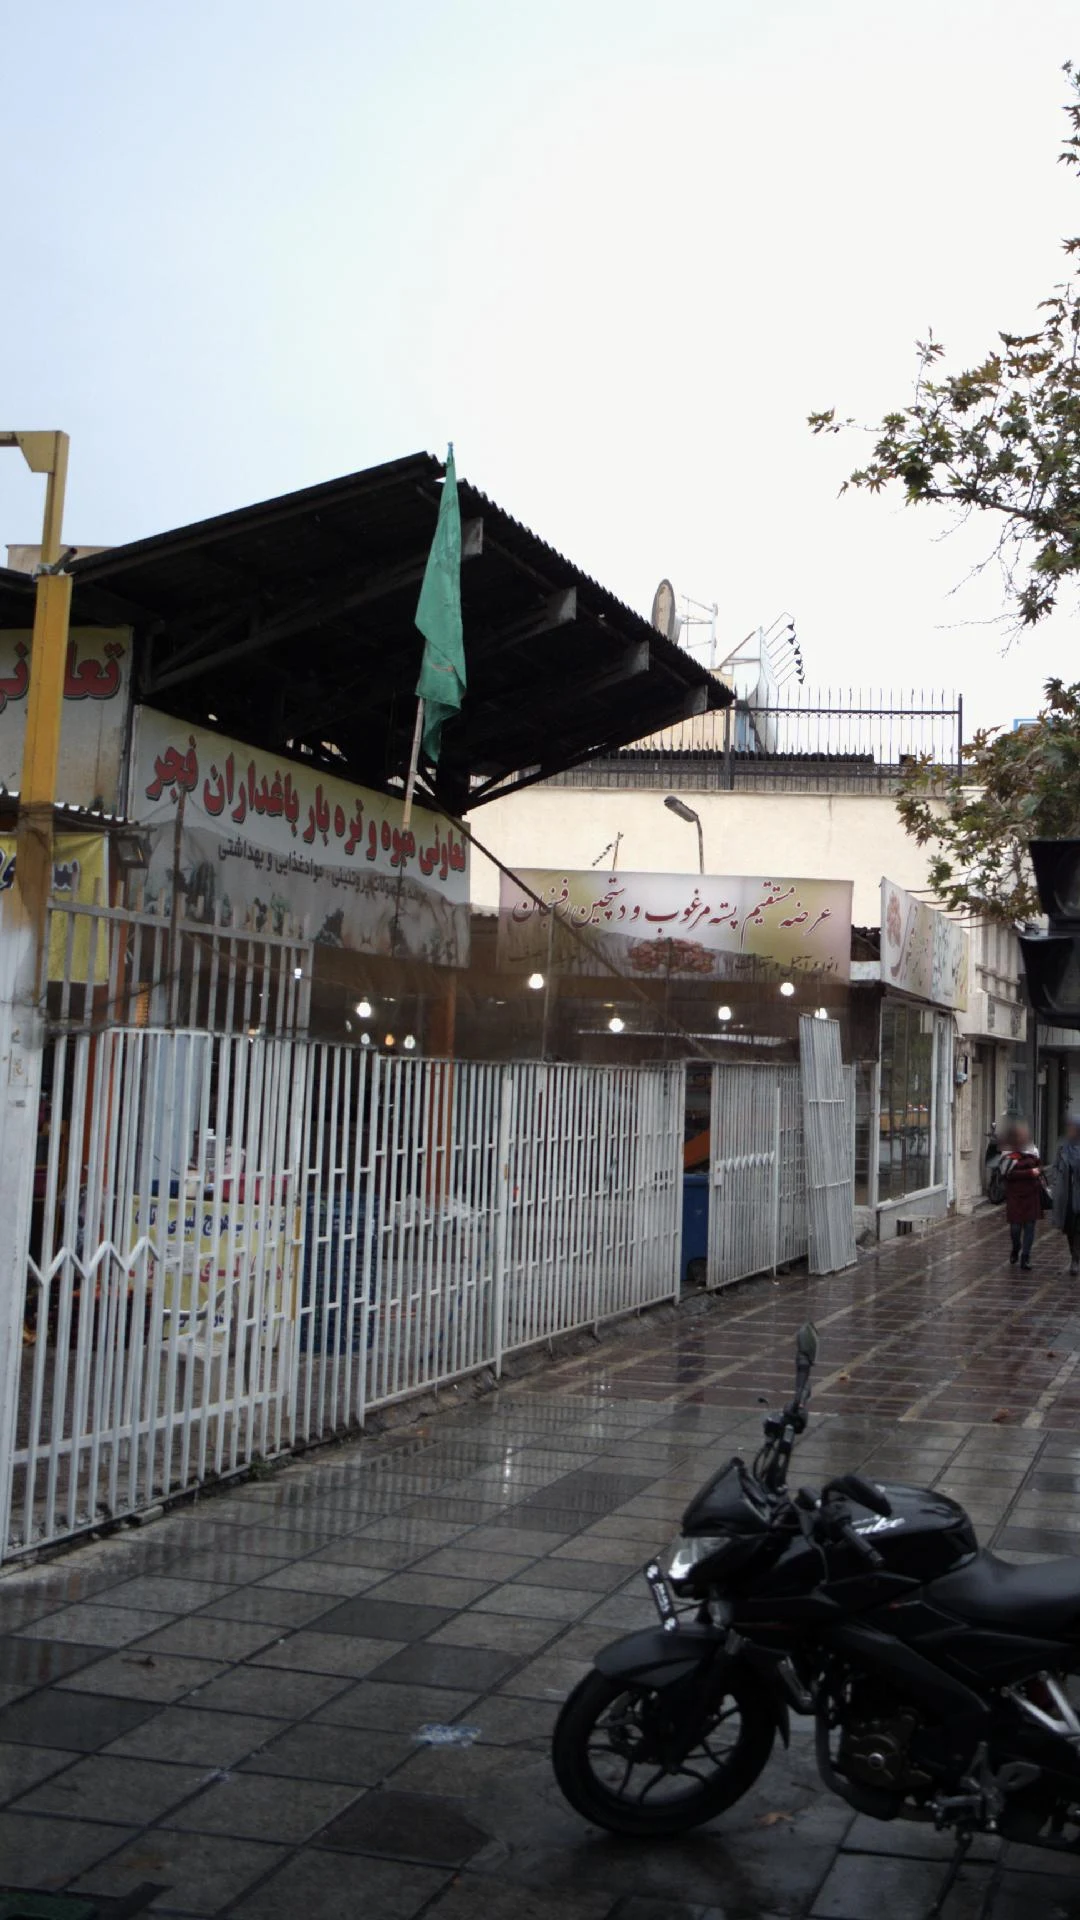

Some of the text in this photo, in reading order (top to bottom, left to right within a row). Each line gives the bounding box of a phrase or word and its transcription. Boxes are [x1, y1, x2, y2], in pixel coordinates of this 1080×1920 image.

[145, 734, 467, 882] تعاونی میوه و تره بار باغداران فجر
[218, 833, 264, 869] بهداشتی
[266, 852, 273, 872] و
[629, 905, 641, 921] و
[645, 888, 711, 934] مرغوب
[708, 903, 738, 930] پسته
[740, 880, 796, 950] مستقیم
[780, 901, 832, 935] عرضه
